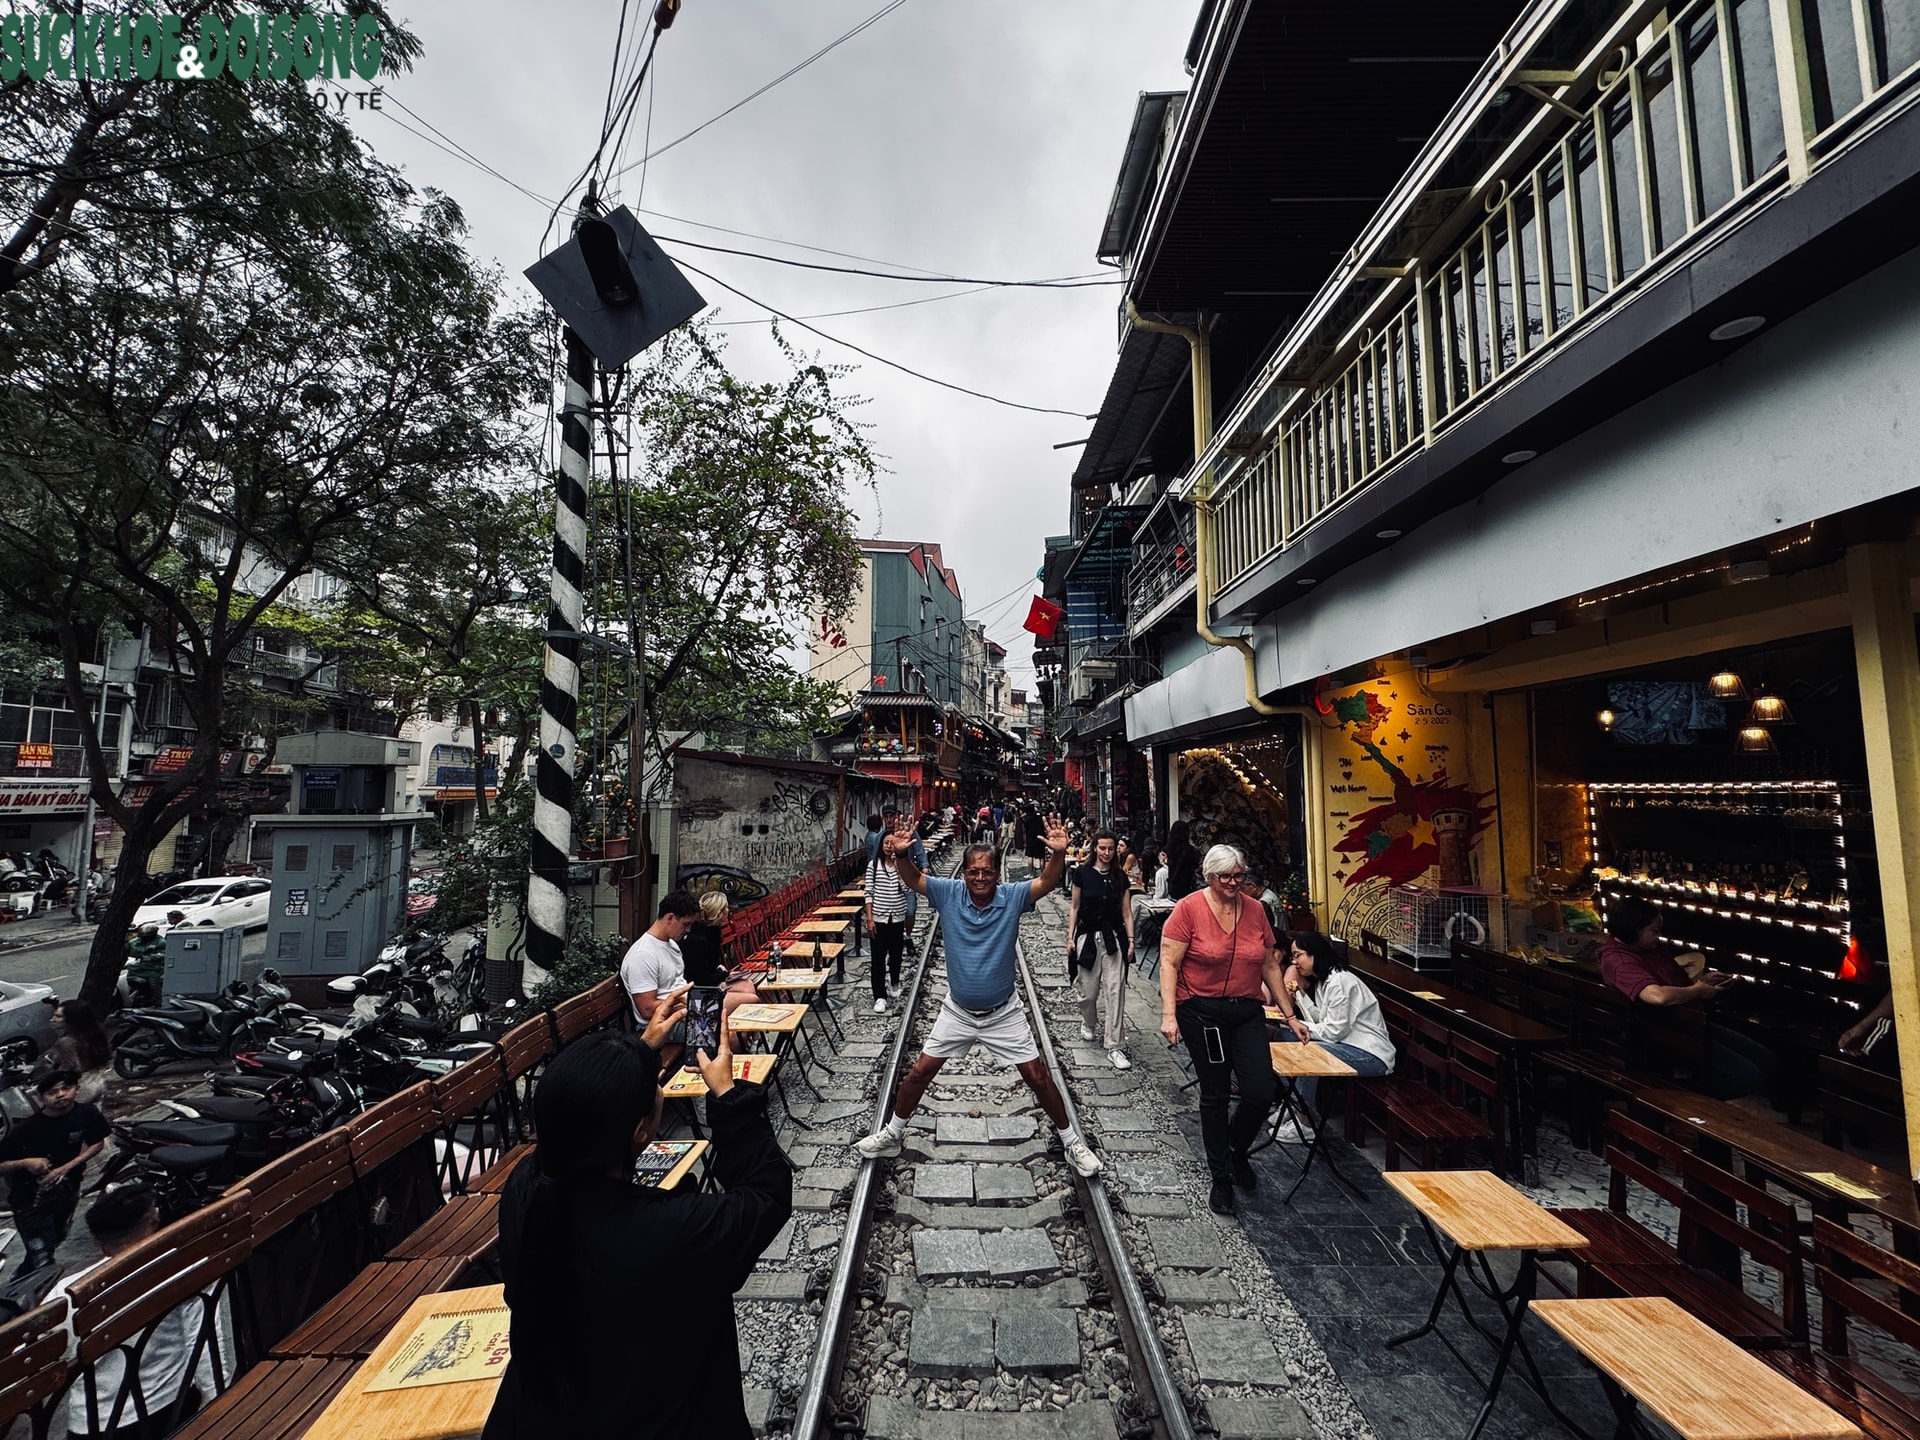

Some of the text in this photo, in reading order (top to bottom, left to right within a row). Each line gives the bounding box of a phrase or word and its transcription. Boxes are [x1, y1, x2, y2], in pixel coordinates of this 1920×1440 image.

[1406, 703, 1452, 716] Sân Ga
[12, 791, 41, 806] BÁN
[38, 791, 59, 806] KÝ
